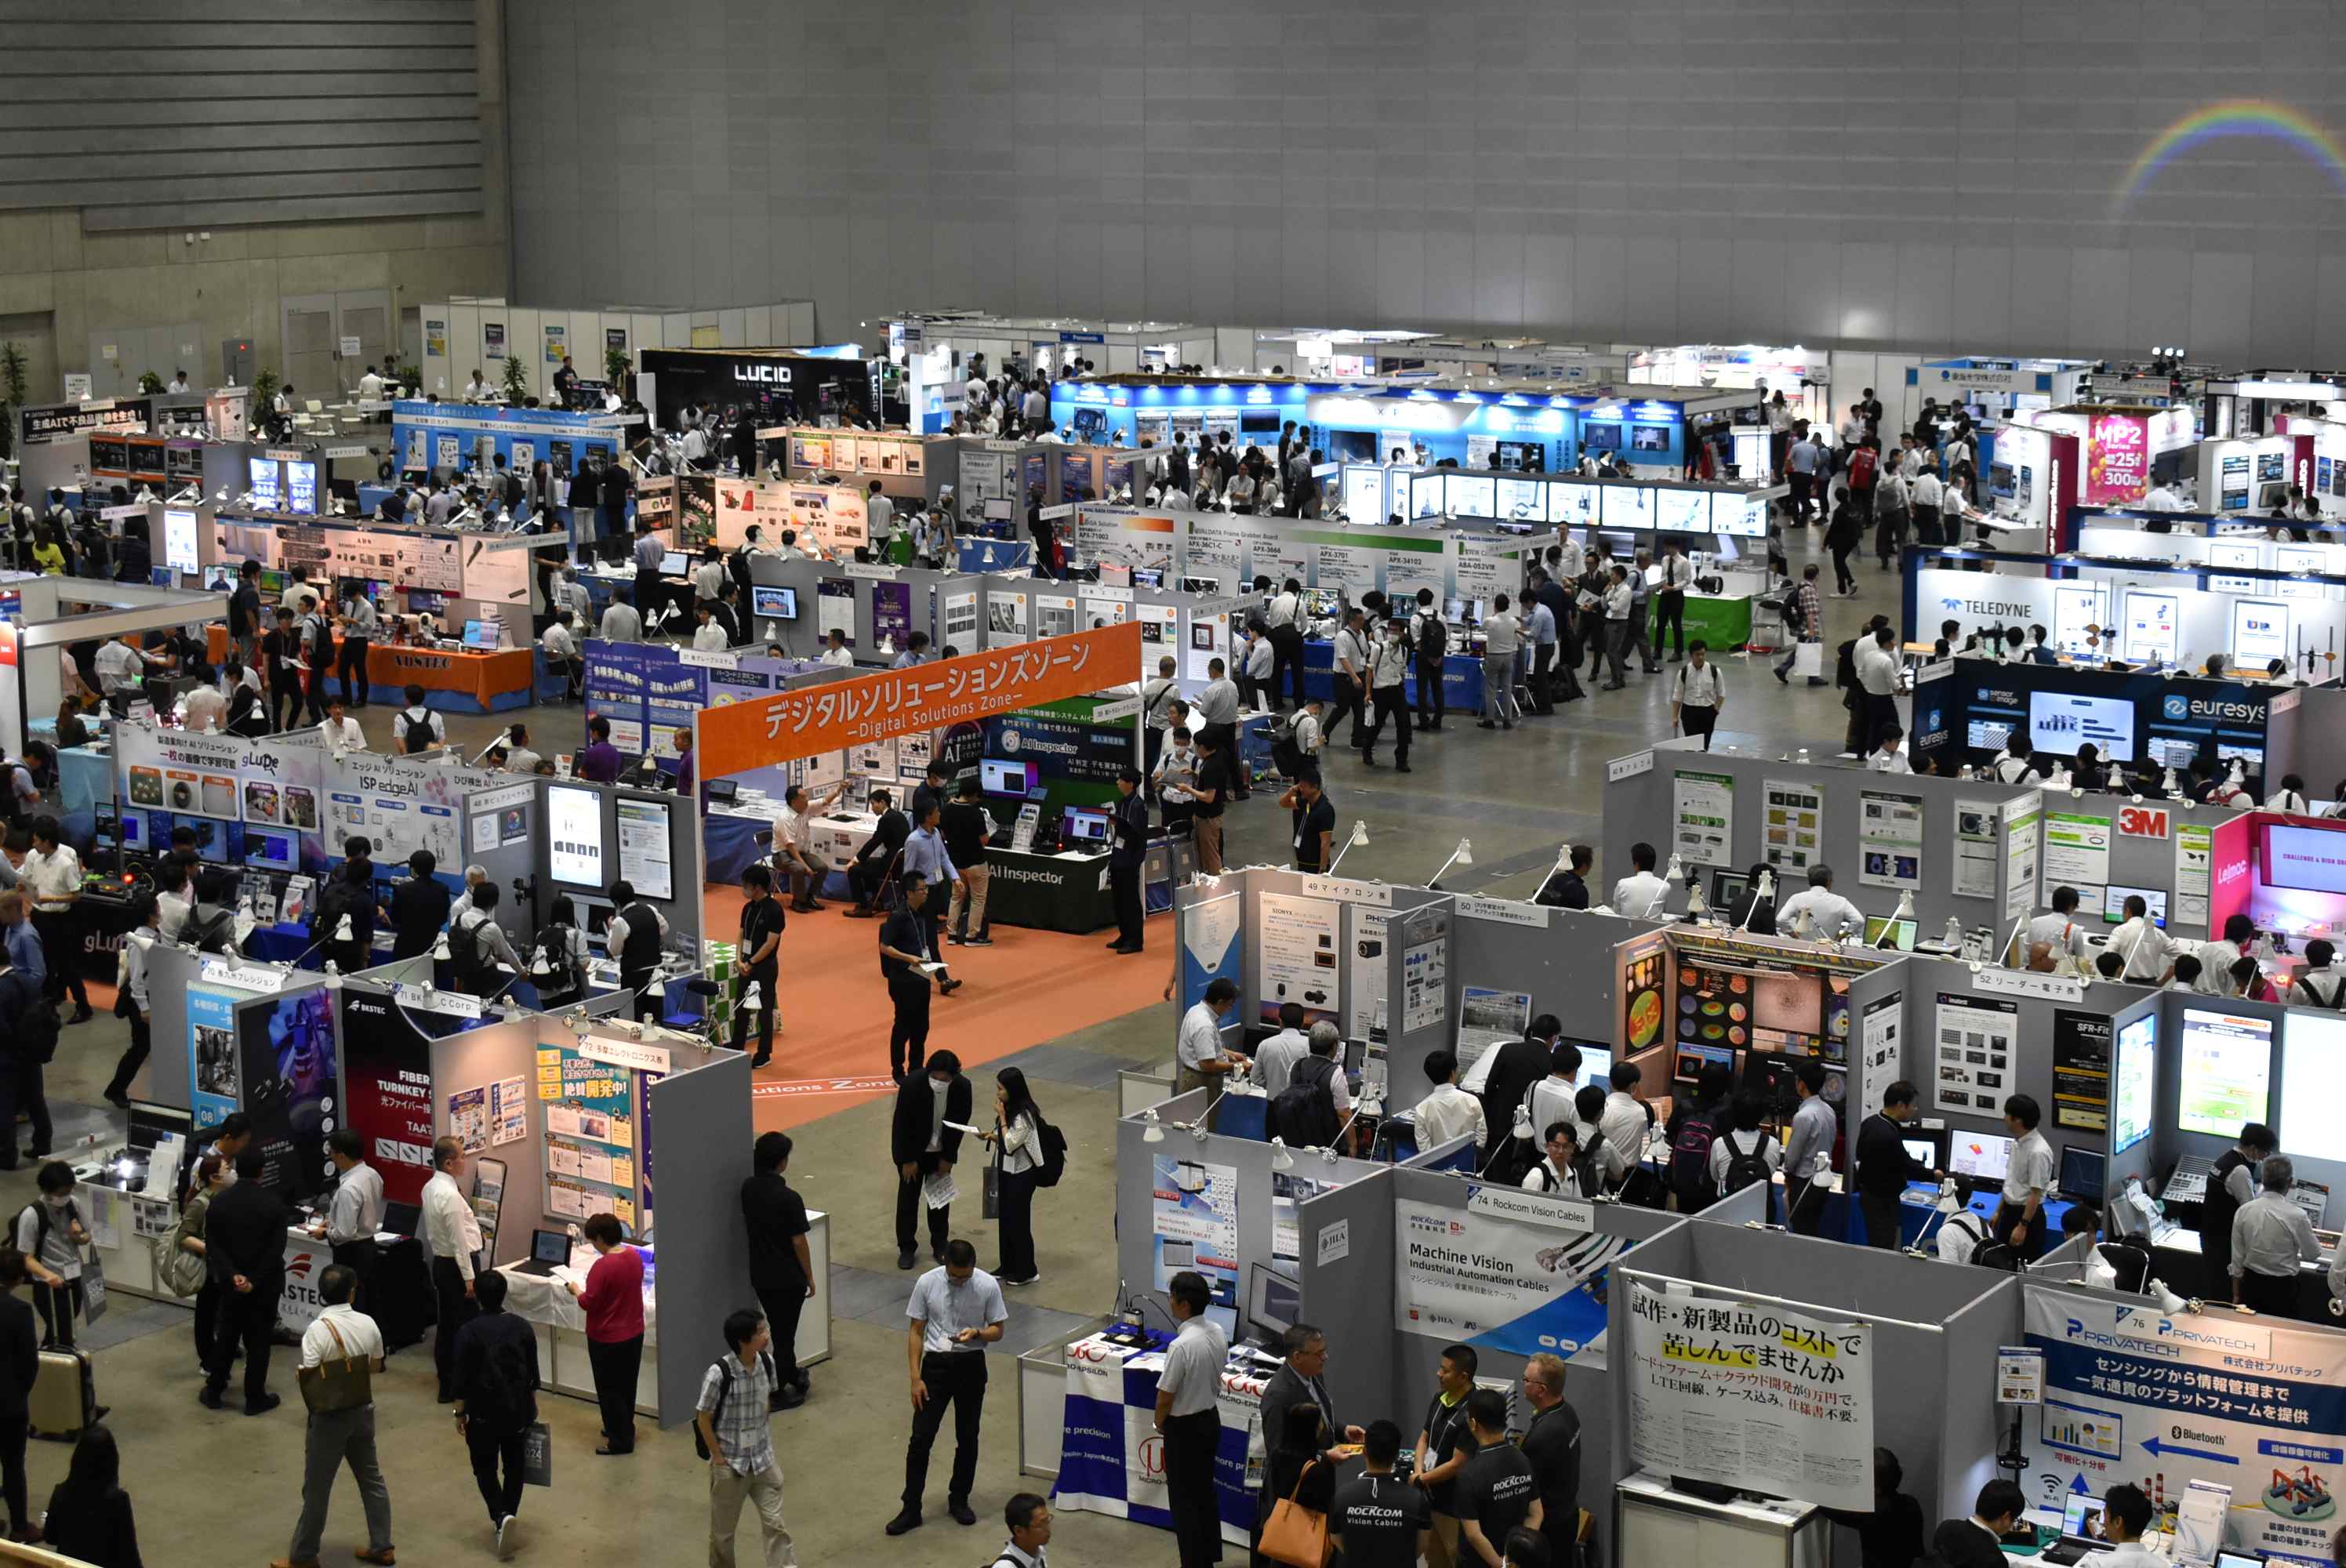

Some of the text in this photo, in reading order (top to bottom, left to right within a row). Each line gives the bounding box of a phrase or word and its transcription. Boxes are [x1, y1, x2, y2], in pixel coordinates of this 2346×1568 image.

[734, 364, 792, 383] LUCID
[2094, 425, 2141, 445] MP2
[2116, 452, 2134, 466] 25
[2104, 472, 2131, 486] 300
[1964, 600, 2032, 618] TELEDYNE
[765, 641, 1091, 740] デジタルソリューションズゾーン
[912, 701, 975, 727] Solutions
[2190, 699, 2264, 724] euresys
[1021, 739, 1080, 755] AI Inspector
[1919, 729, 1949, 747] euresys
[159, 750, 237, 770] 一枚の画像で学習可能
[944, 744, 961, 763] AI
[352, 760, 372, 771] エッジ
[382, 764, 427, 779] ソリューション
[359, 775, 419, 797] ISP edgeAI
[2119, 808, 2167, 837] 3M
[2282, 852, 2314, 862] CHALLENGE
[989, 865, 1065, 885] AI Inspector
[1308, 882, 1318, 891] 49
[1272, 907, 1293, 916] SIONYX
[1461, 902, 1471, 911] 50
[207, 968, 216, 977] 70
[1979, 975, 1991, 985] 52
[401, 990, 408, 999] 71
[361, 1004, 387, 1015] BKSTEC
[2076, 1022, 2109, 1035] SFR-Fit
[584, 1041, 594, 1051] 72
[399, 1069, 430, 1086] FIBER
[376, 1080, 427, 1098] TURNKEY
[564, 1079, 627, 1098] 絶賛開発中!
[752, 1084, 823, 1094] utions
[200, 1110, 214, 1123] 08
[1477, 1195, 1586, 1223] 74 Rockcom Vision Cables
[1411, 1214, 1447, 1227] ROCKCOM
[1329, 1232, 1346, 1250] JIIA
[1410, 1243, 1514, 1273] Machine Vision
[1409, 1259, 1550, 1293] Industrial Automation Cables
[1632, 1292, 1863, 1356] 試作・新製品のコストで
[2083, 1330, 2181, 1358] PRIVATECH
[2133, 1318, 2256, 1352] 76 PRIVATECH
[1661, 1332, 1845, 1384] 苦しんでませんか
[2095, 1356, 2290, 1403] センシングから情報管理まで
[2075, 1374, 2309, 1425] 一気通貫のプラットフォームを提供
[1073, 1426, 1111, 1439] precision
[2182, 1427, 2225, 1446] Bluetooth
[1492, 1475, 1533, 1493] ROCKCOM
[1493, 1490, 1514, 1501] Vision
[2043, 1493, 2060, 1503] Wi-Fi
[1347, 1504, 1403, 1518] ROCKCOM
[1347, 1517, 1403, 1527] Vision Cables
[2268, 1522, 2326, 1539] 装置の状態監視
